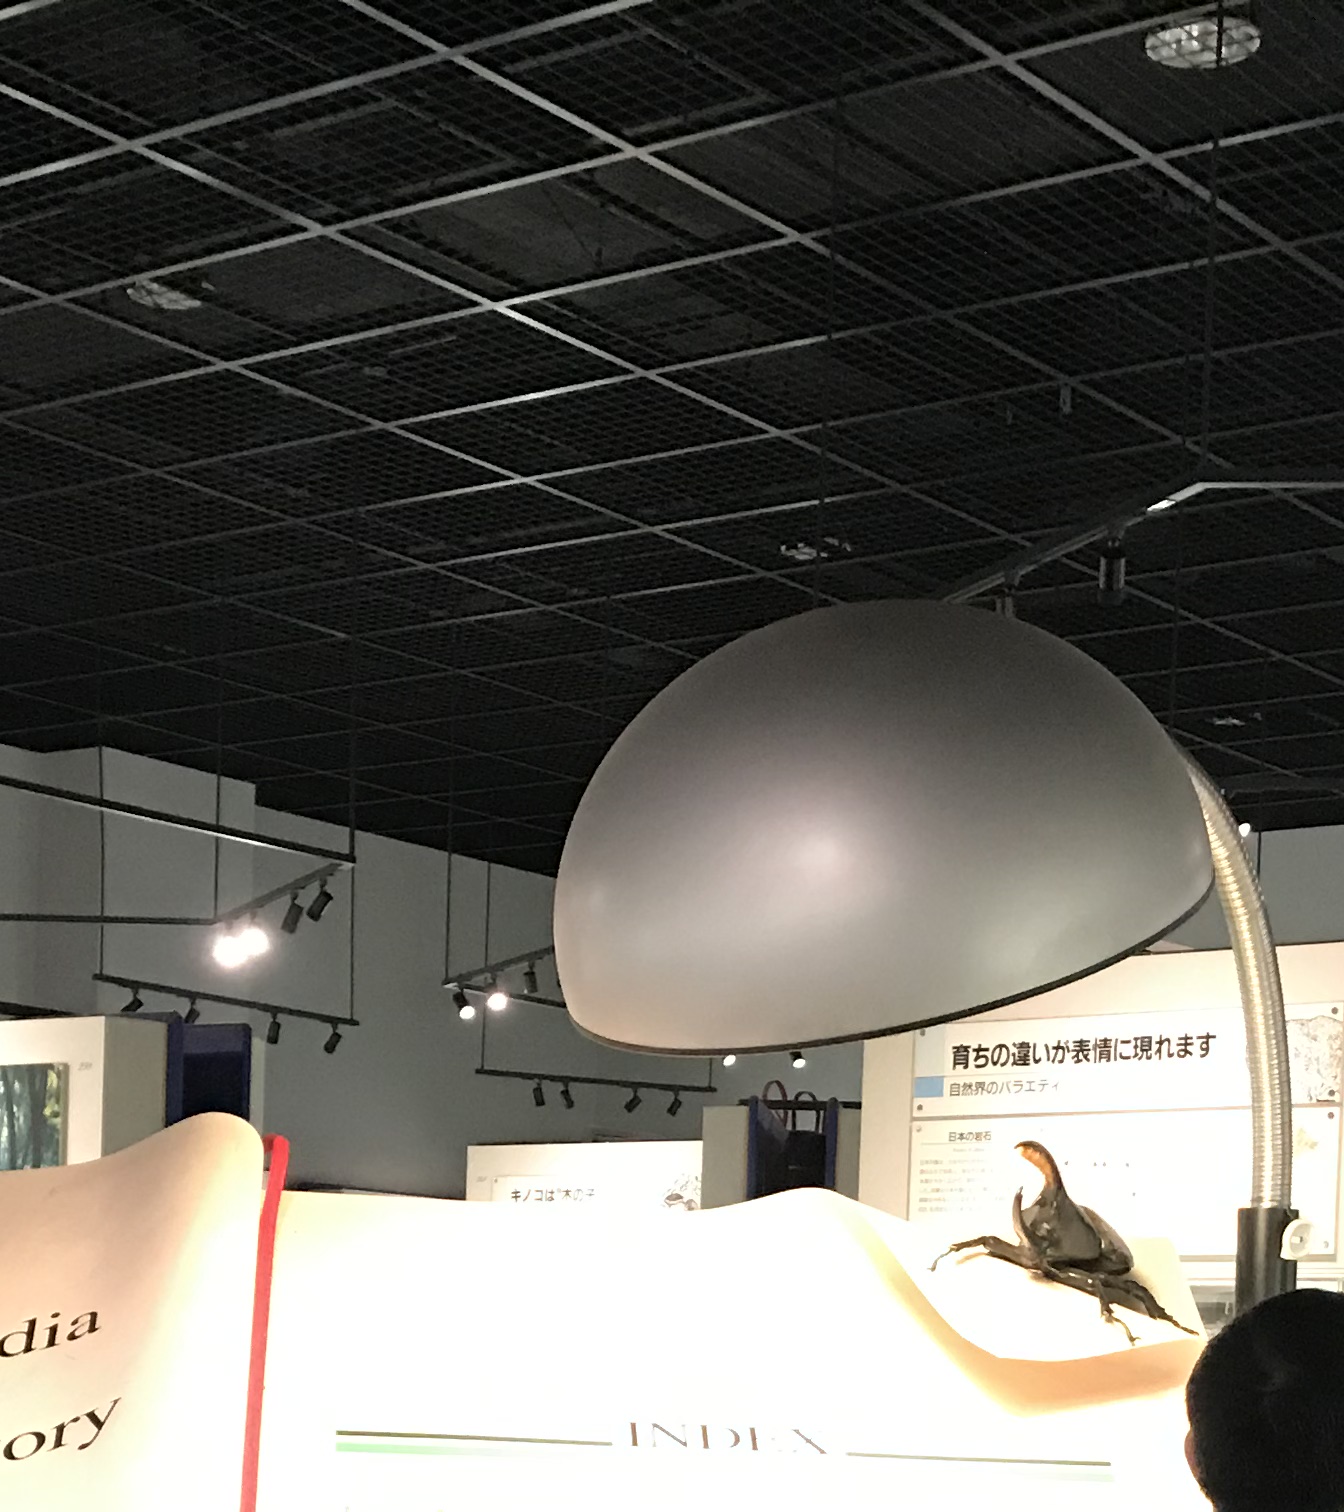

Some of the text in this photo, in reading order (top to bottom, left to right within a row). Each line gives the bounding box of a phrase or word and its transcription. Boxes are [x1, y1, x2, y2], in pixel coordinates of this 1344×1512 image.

[951, 1032, 1217, 1070] 育ちの違いが表情に現れます
